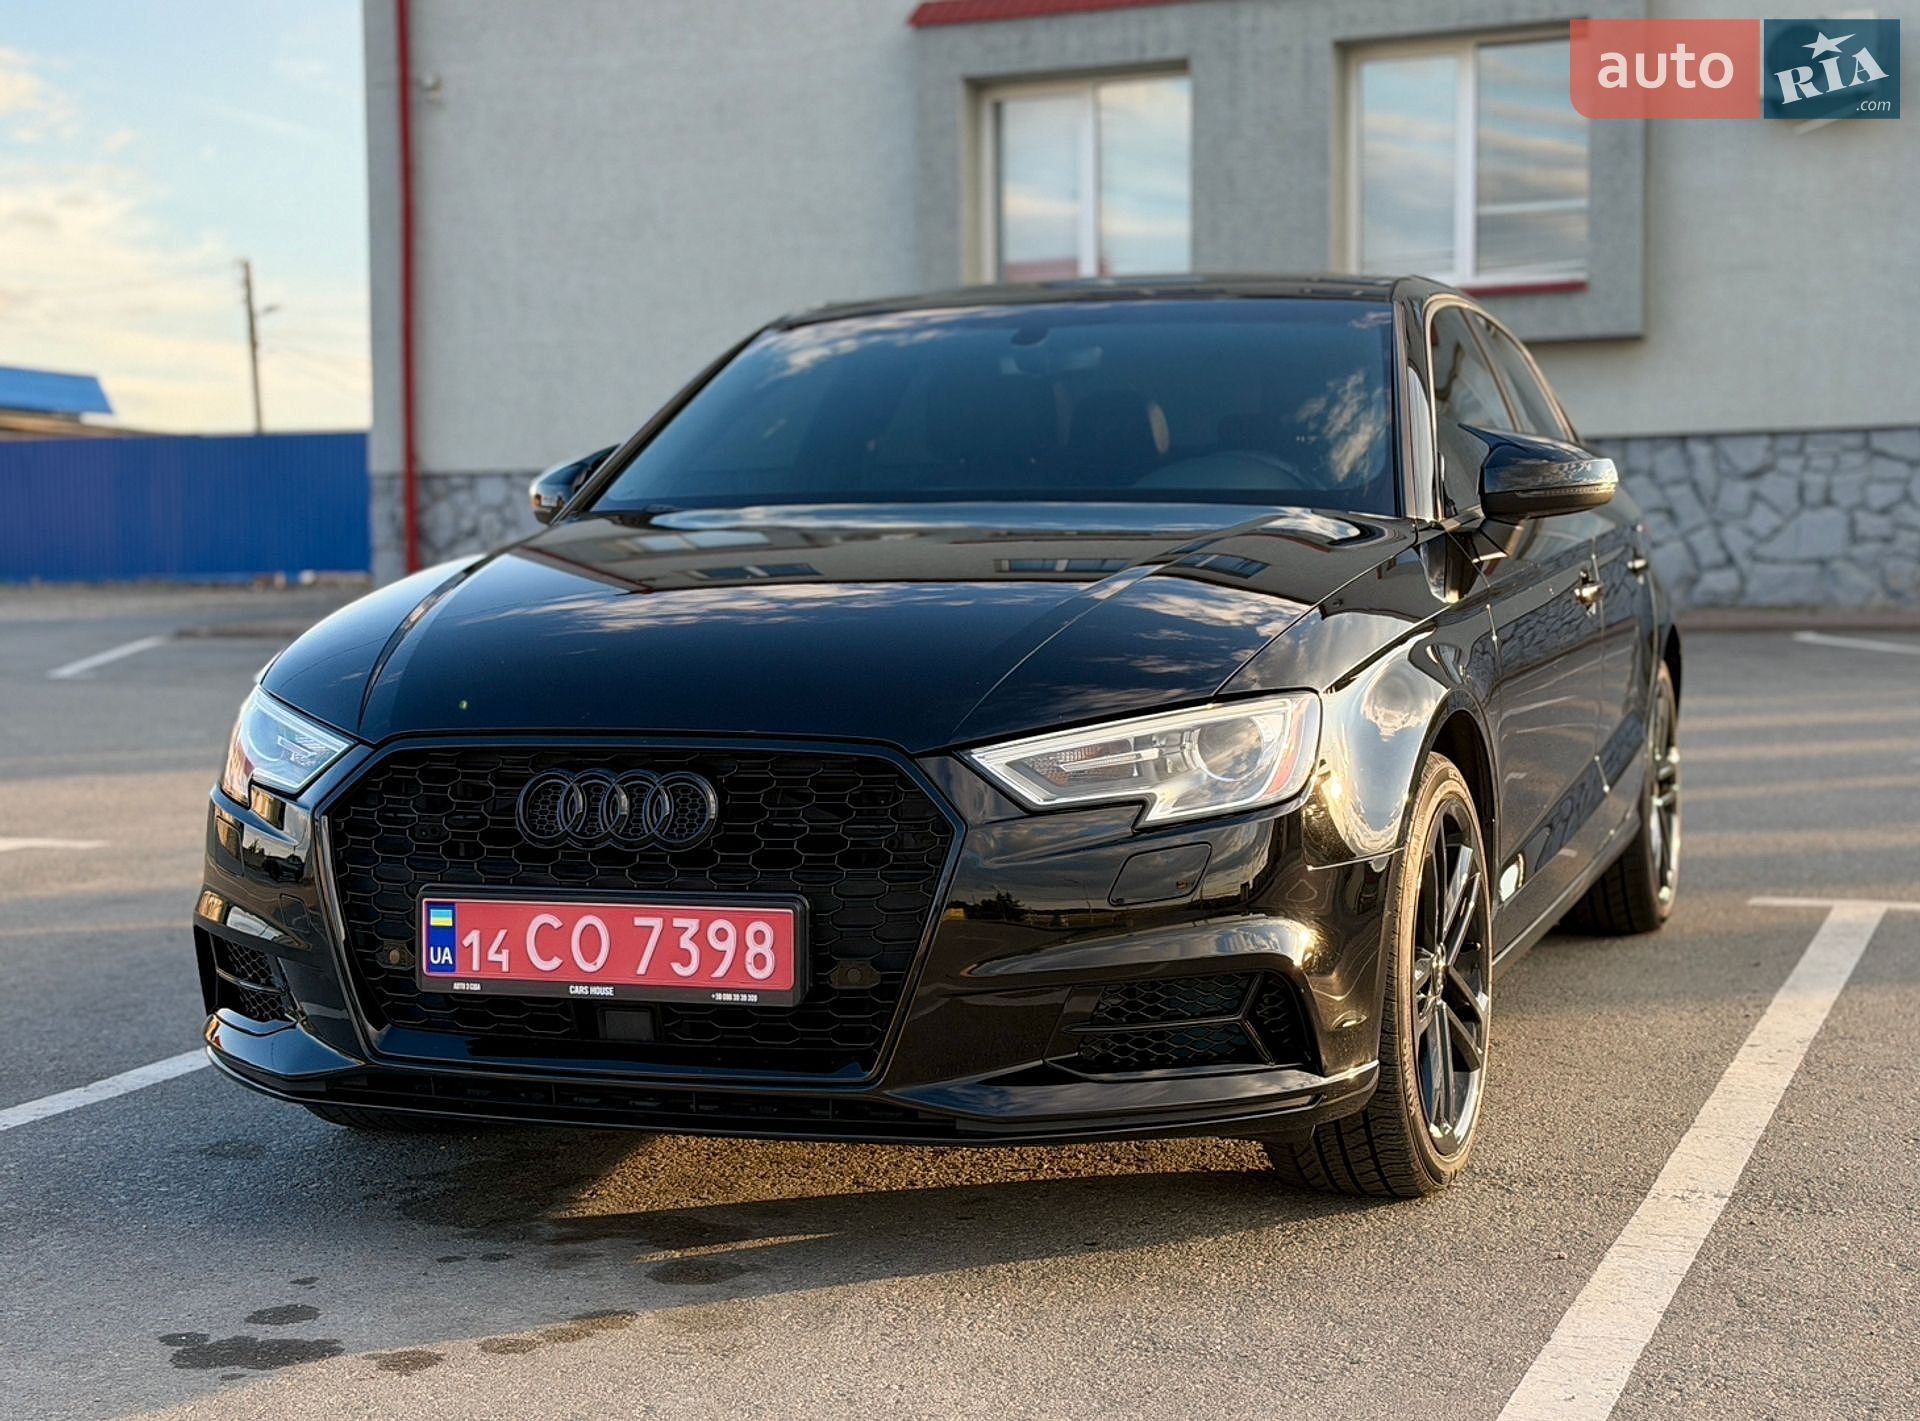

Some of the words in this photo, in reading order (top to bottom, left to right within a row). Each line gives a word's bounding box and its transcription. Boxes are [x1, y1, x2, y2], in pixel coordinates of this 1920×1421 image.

[430, 945, 453, 965] UA
[463, 929, 509, 972] 14
[525, 913, 610, 973] CO
[632, 917, 775, 981] 7398
[569, 985, 590, 995] CARS
[590, 986, 614, 996] HOUSE
